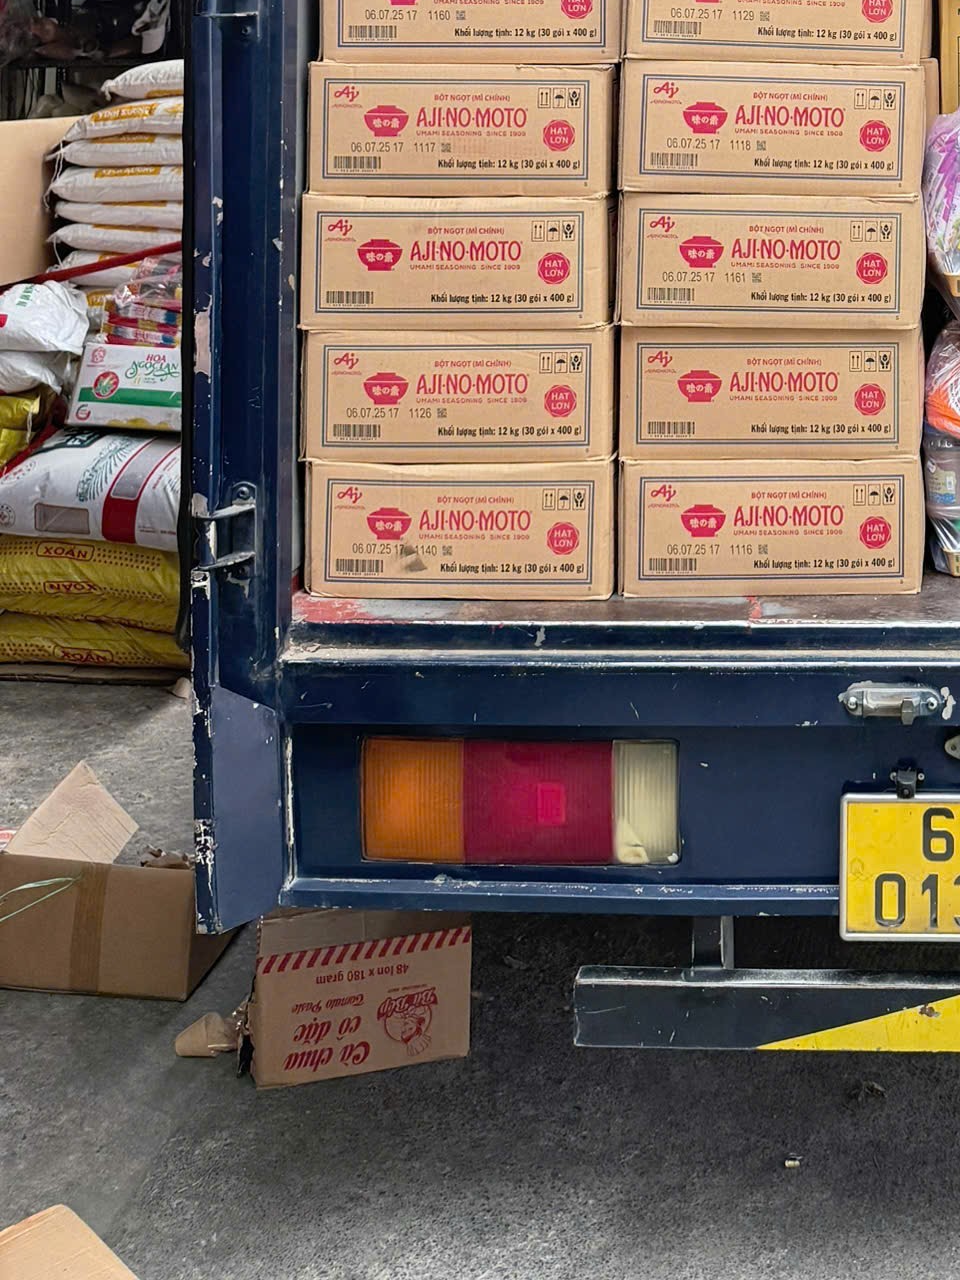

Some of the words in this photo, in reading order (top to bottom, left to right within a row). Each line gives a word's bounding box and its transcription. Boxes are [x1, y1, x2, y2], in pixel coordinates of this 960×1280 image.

[365, 10, 404, 20] 06.07.25
[407, 11, 417, 20] 17
[428, 11, 450, 20] 1160
[671, 8, 710, 19] 06.07.25
[712, 9, 723, 20] 17
[733, 11, 754, 21] 1129
[351, 142, 391, 152] 06.07.25
[393, 142, 403, 152] 17
[414, 143, 435, 153] 1117
[667, 139, 707, 149] 06.07.25
[710, 139, 720, 150] 17
[730, 140, 751, 151] 1118
[662, 272, 702, 282] 06.07.25
[705, 272, 715, 283] 17
[725, 272, 746, 283] 1161
[146, 354, 166, 362] HOA
[347, 408, 386, 418] 06.07.25
[389, 408, 399, 418] 17
[409, 408, 432, 419] 1126
[750, 491, 765, 500] BỘT
[766, 491, 788, 500] NGỌT
[667, 544, 706, 555] 06.07.25
[709, 544, 720, 555] 17
[730, 544, 753, 555] 1116
[753, 557, 770, 568] Khối
[772, 559, 792, 569] lượng
[813, 559, 823, 567] 12
[825, 558, 834, 568] kg
[851, 557, 862, 568] gói
[871, 557, 886, 566] 400
[368, 968, 375, 976] x
[377, 965, 394, 976] lon
[396, 963, 409, 974] 48
[316, 972, 344, 985] gram
[348, 969, 365, 982] 180
[325, 993, 364, 1009] Tomato
[291, 999, 322, 1015] Paste
[293, 1017, 332, 1045] đặc
[337, 1016, 361, 1040] cô
[340, 1041, 371, 1066] Cà
